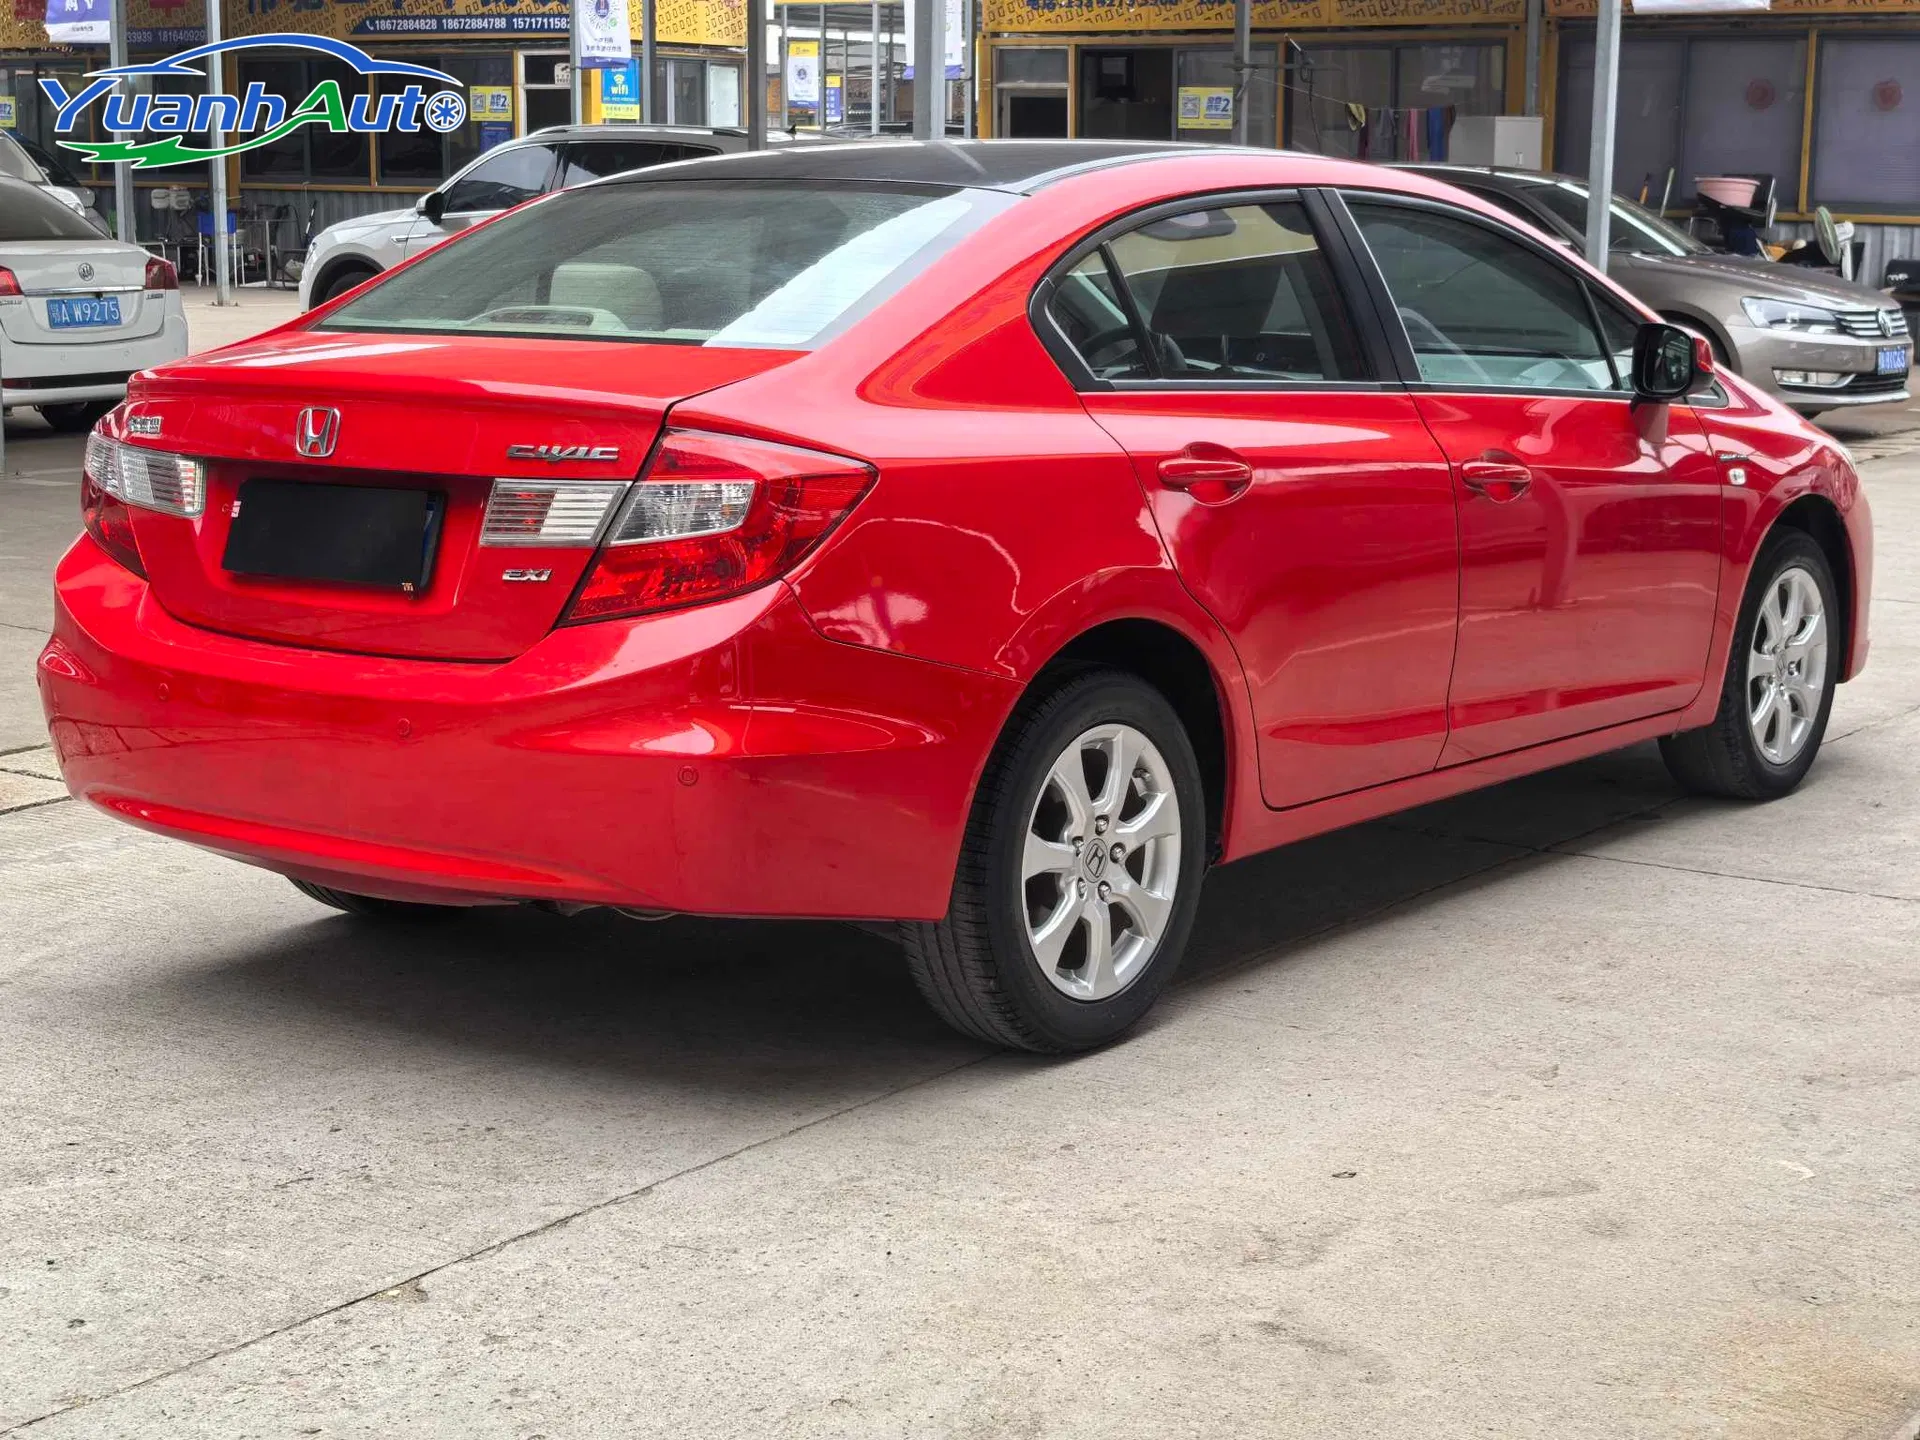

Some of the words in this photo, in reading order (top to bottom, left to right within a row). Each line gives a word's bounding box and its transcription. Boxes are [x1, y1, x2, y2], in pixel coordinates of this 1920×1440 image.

[375, 20, 437, 31] 18672884828
[442, 18, 506, 30] 18672884788
[74, 301, 119, 322] W9275
[507, 443, 619, 462] CIVIC
